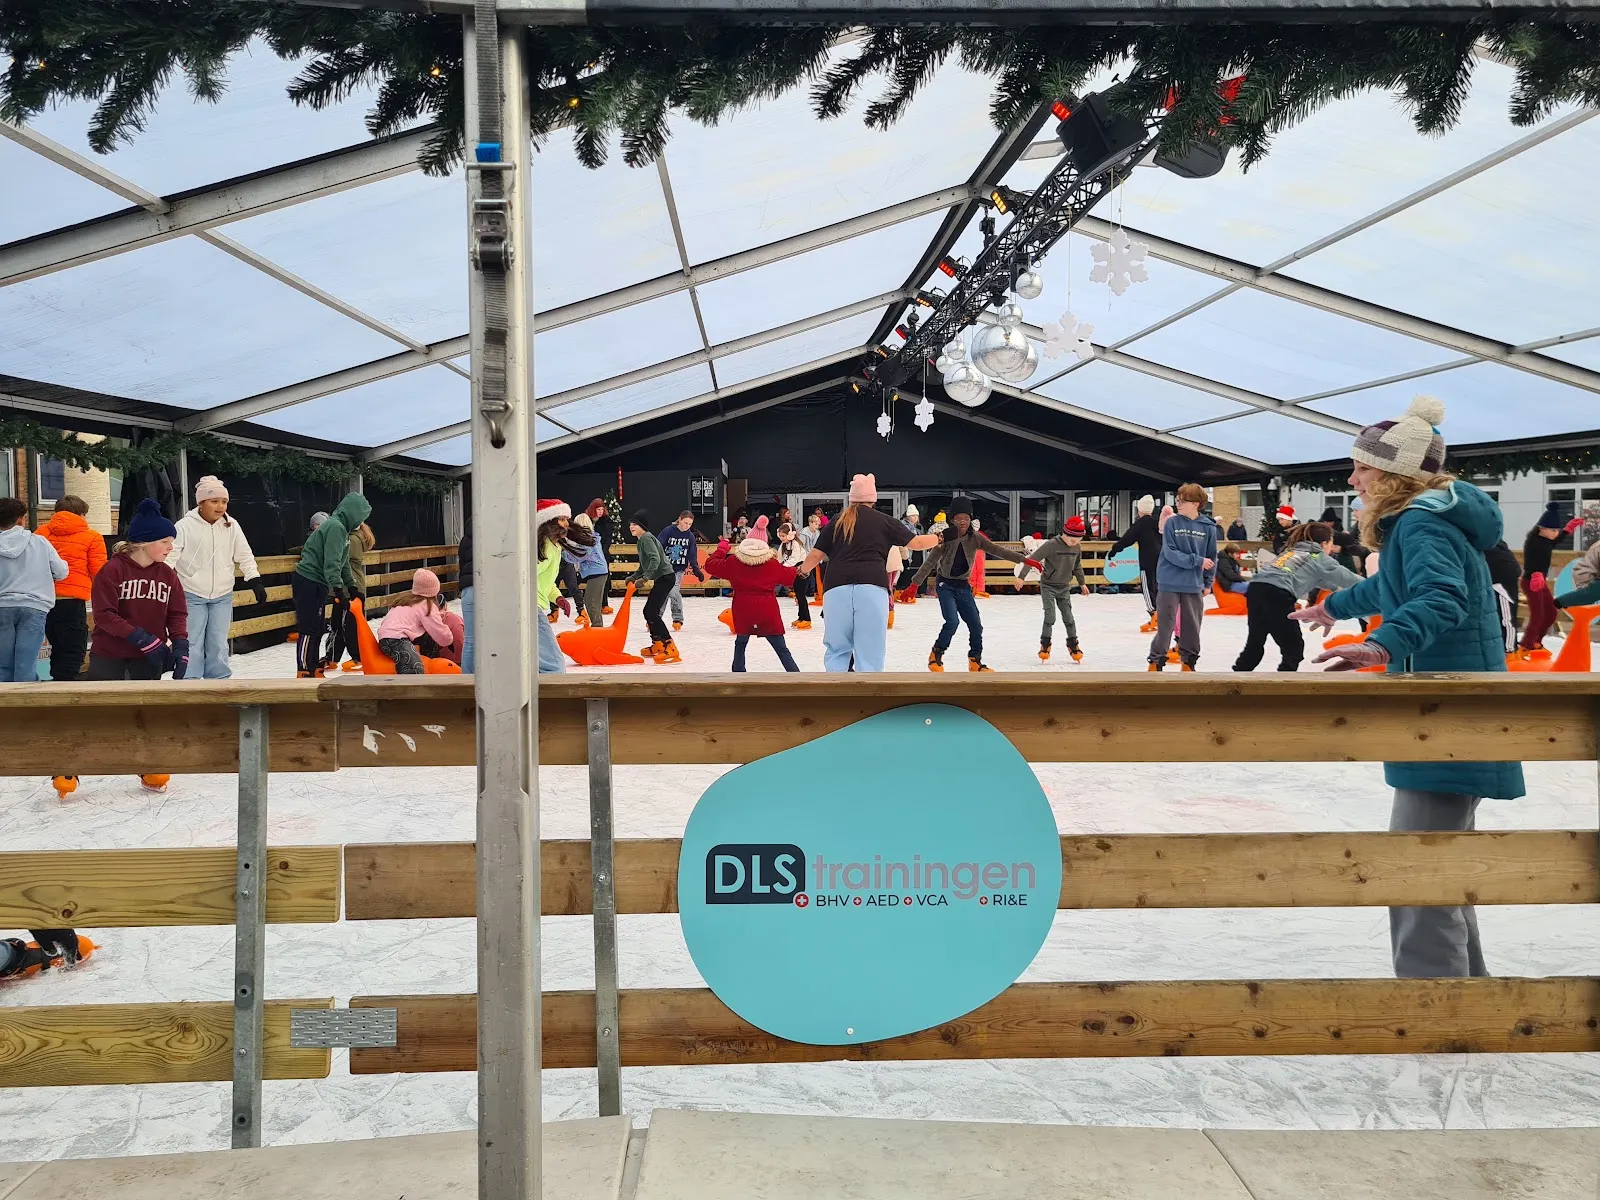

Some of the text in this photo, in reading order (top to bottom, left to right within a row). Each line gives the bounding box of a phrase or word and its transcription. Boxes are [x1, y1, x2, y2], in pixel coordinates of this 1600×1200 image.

[118, 579, 172, 605] HICAG
[714, 853, 1036, 899] DLS trainingen
[816, 894, 1028, 907] BHV AED VCA RI&E
